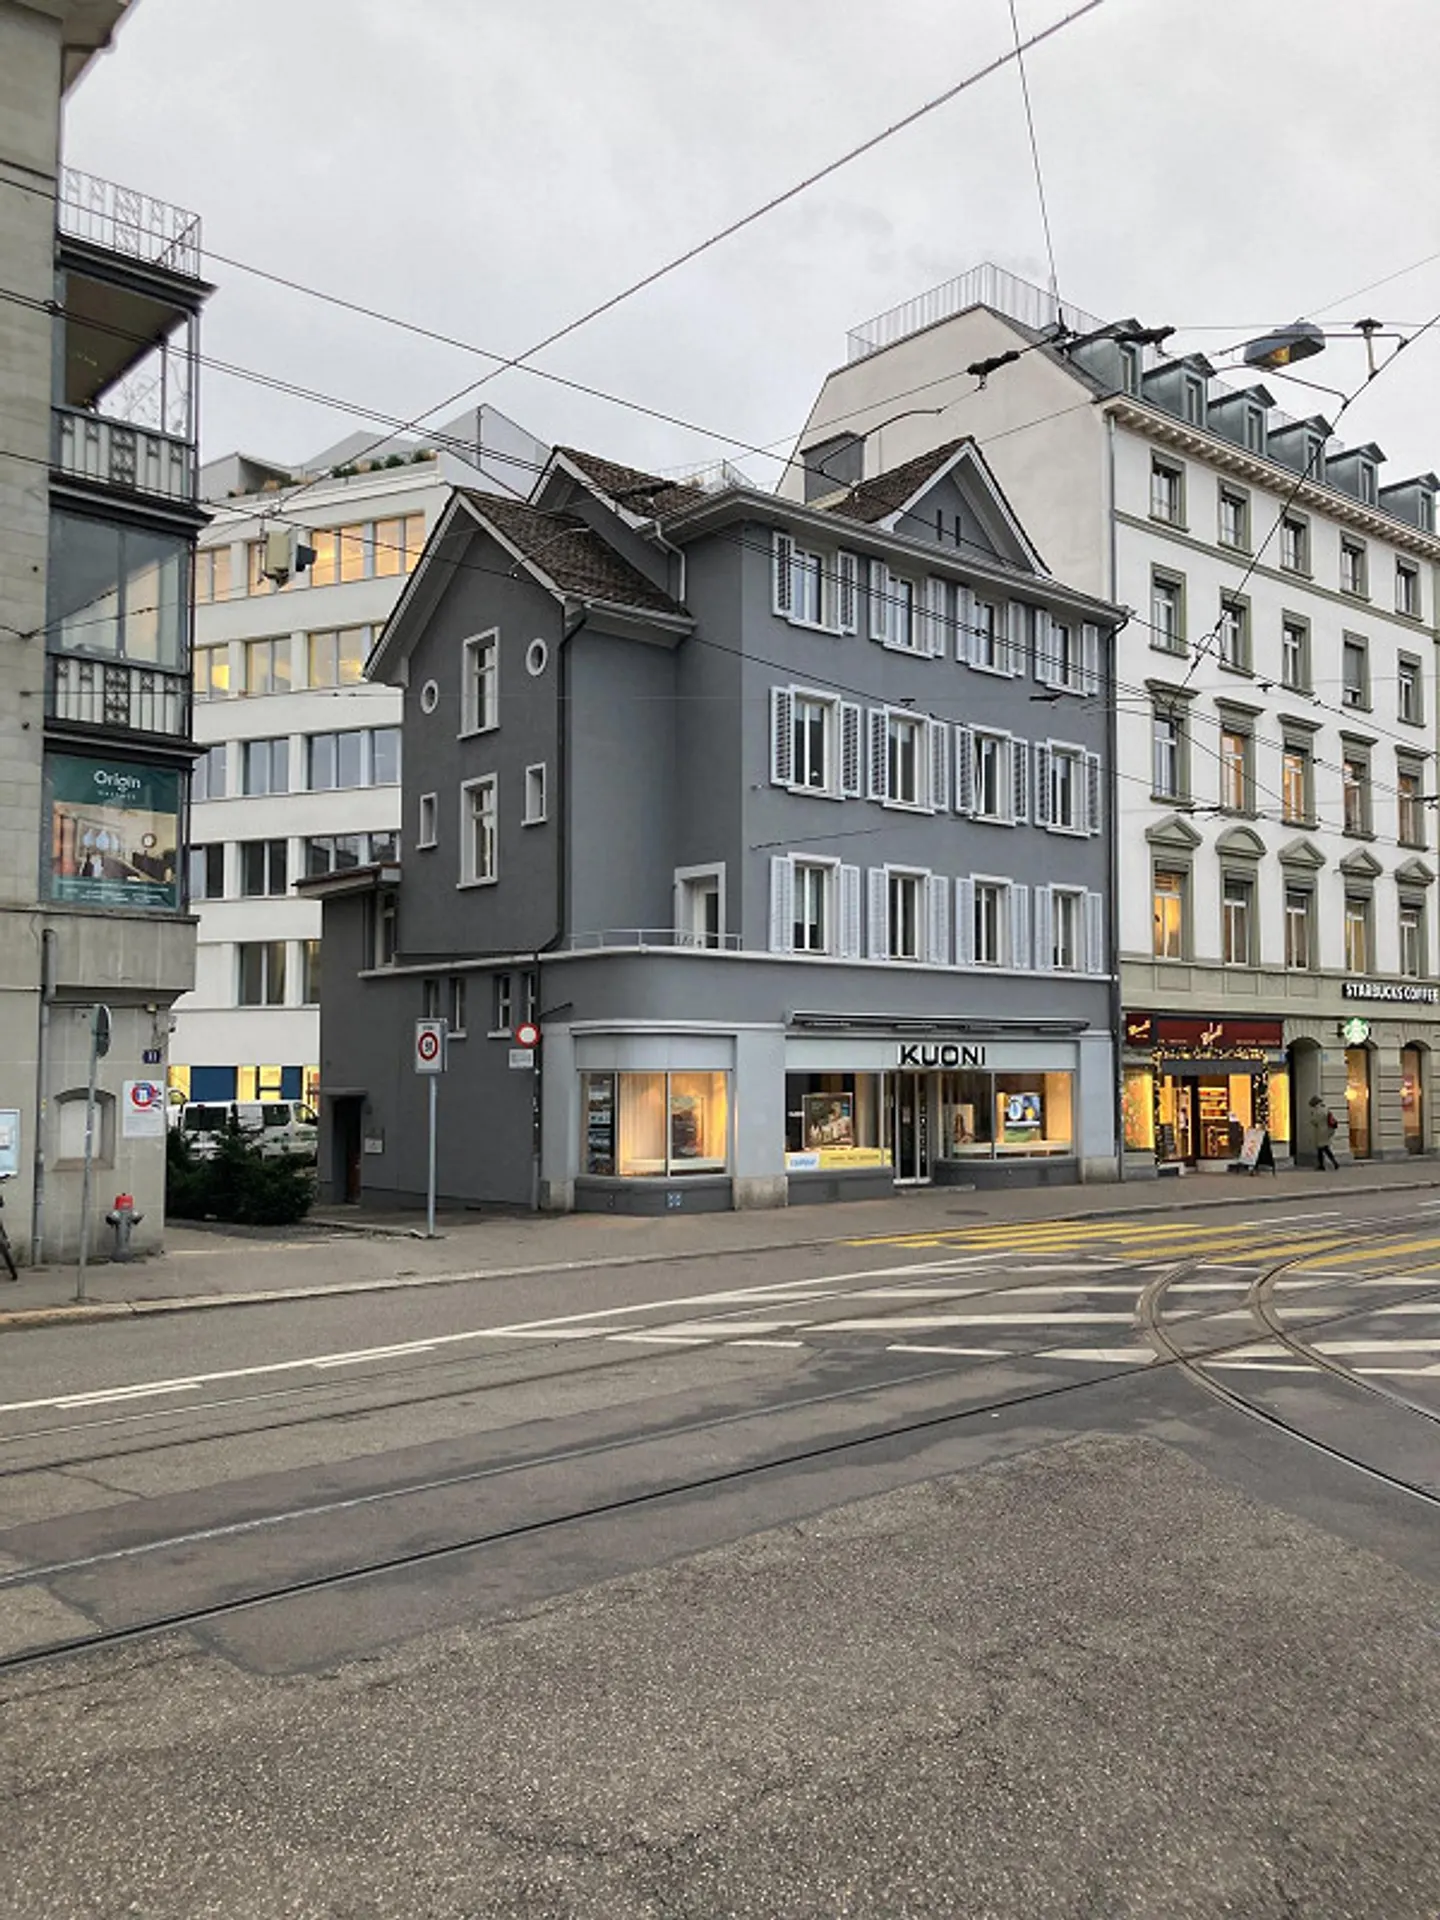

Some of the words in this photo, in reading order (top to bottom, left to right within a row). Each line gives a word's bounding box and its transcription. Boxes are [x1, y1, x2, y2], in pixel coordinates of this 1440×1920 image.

[93, 770, 141, 793] Origin
[1346, 983, 1403, 1000] STARBUCKS
[1404, 986, 1438, 1002] COFFEE
[899, 1044, 986, 1067] KUONI
